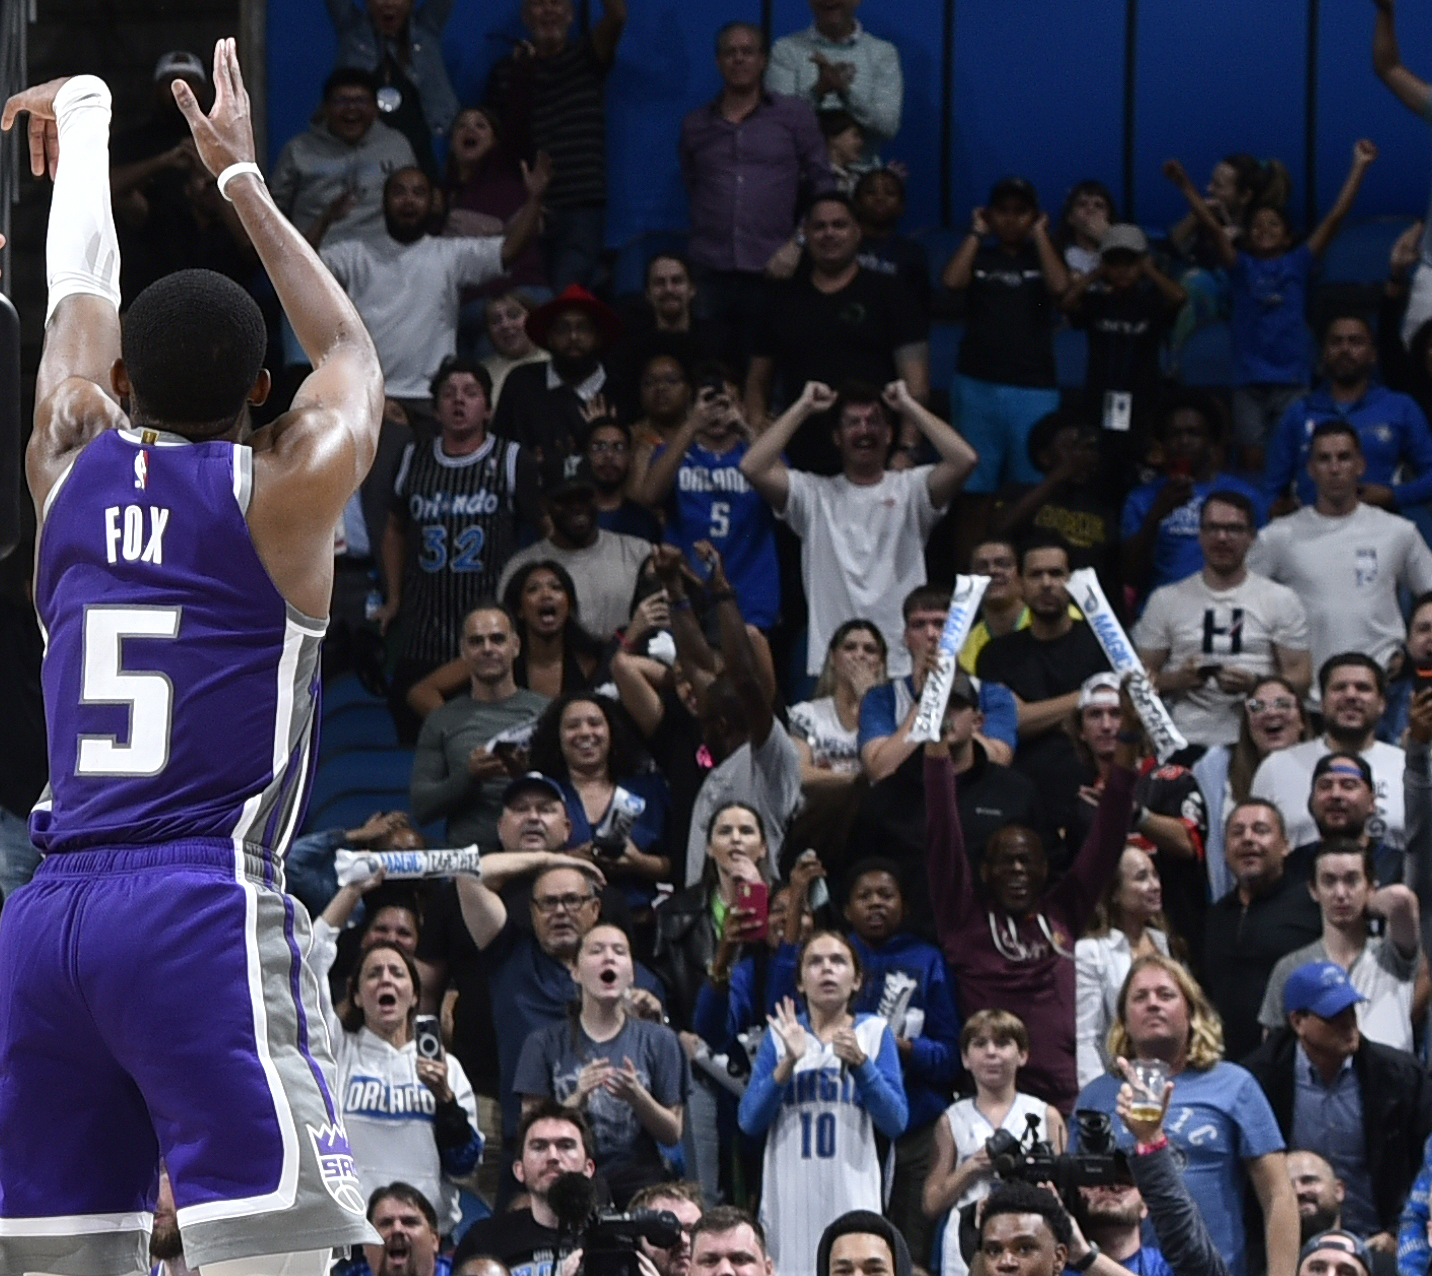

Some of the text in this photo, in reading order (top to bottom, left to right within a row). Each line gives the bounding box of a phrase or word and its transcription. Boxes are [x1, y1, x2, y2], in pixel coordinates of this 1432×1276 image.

[105, 505, 169, 566] FOX
[709, 500, 731, 539] 5
[419, 524, 486, 573] 32
[75, 605, 181, 776] 5
[800, 1111, 836, 1160] 10
